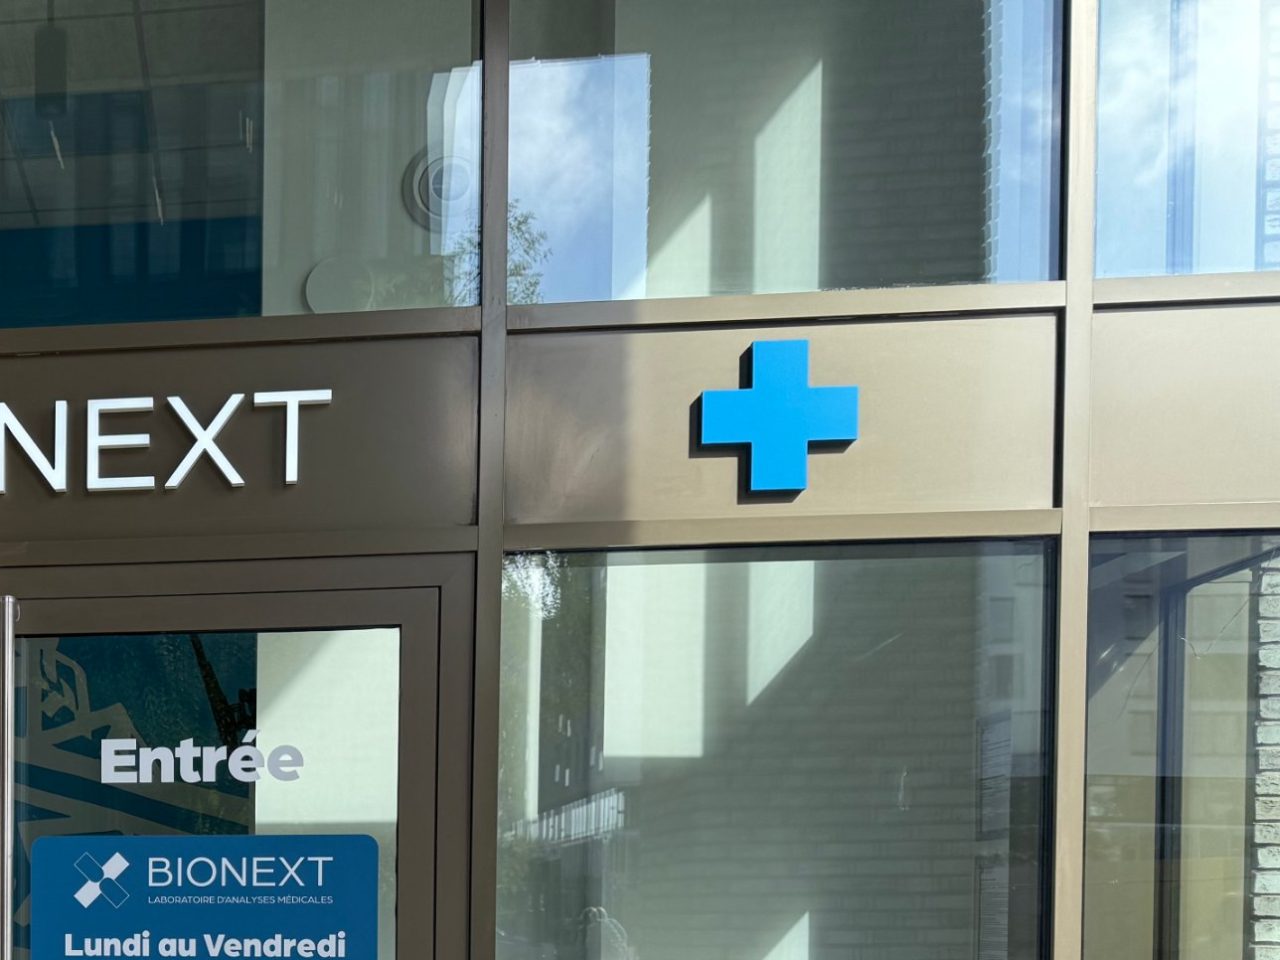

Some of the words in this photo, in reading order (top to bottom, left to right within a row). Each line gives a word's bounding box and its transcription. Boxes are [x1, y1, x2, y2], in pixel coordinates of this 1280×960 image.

[101, 730, 304, 784] Entrée
[148, 856, 334, 887] BIONEXT
[148, 895, 215, 904] LABORATOIRE
[217, 895, 276, 904] D'ANALYSES
[277, 894, 334, 904] MÉDICALES
[65, 930, 150, 957] Lundi
[158, 938, 197, 957] au
[203, 930, 346, 958] Vendredi
